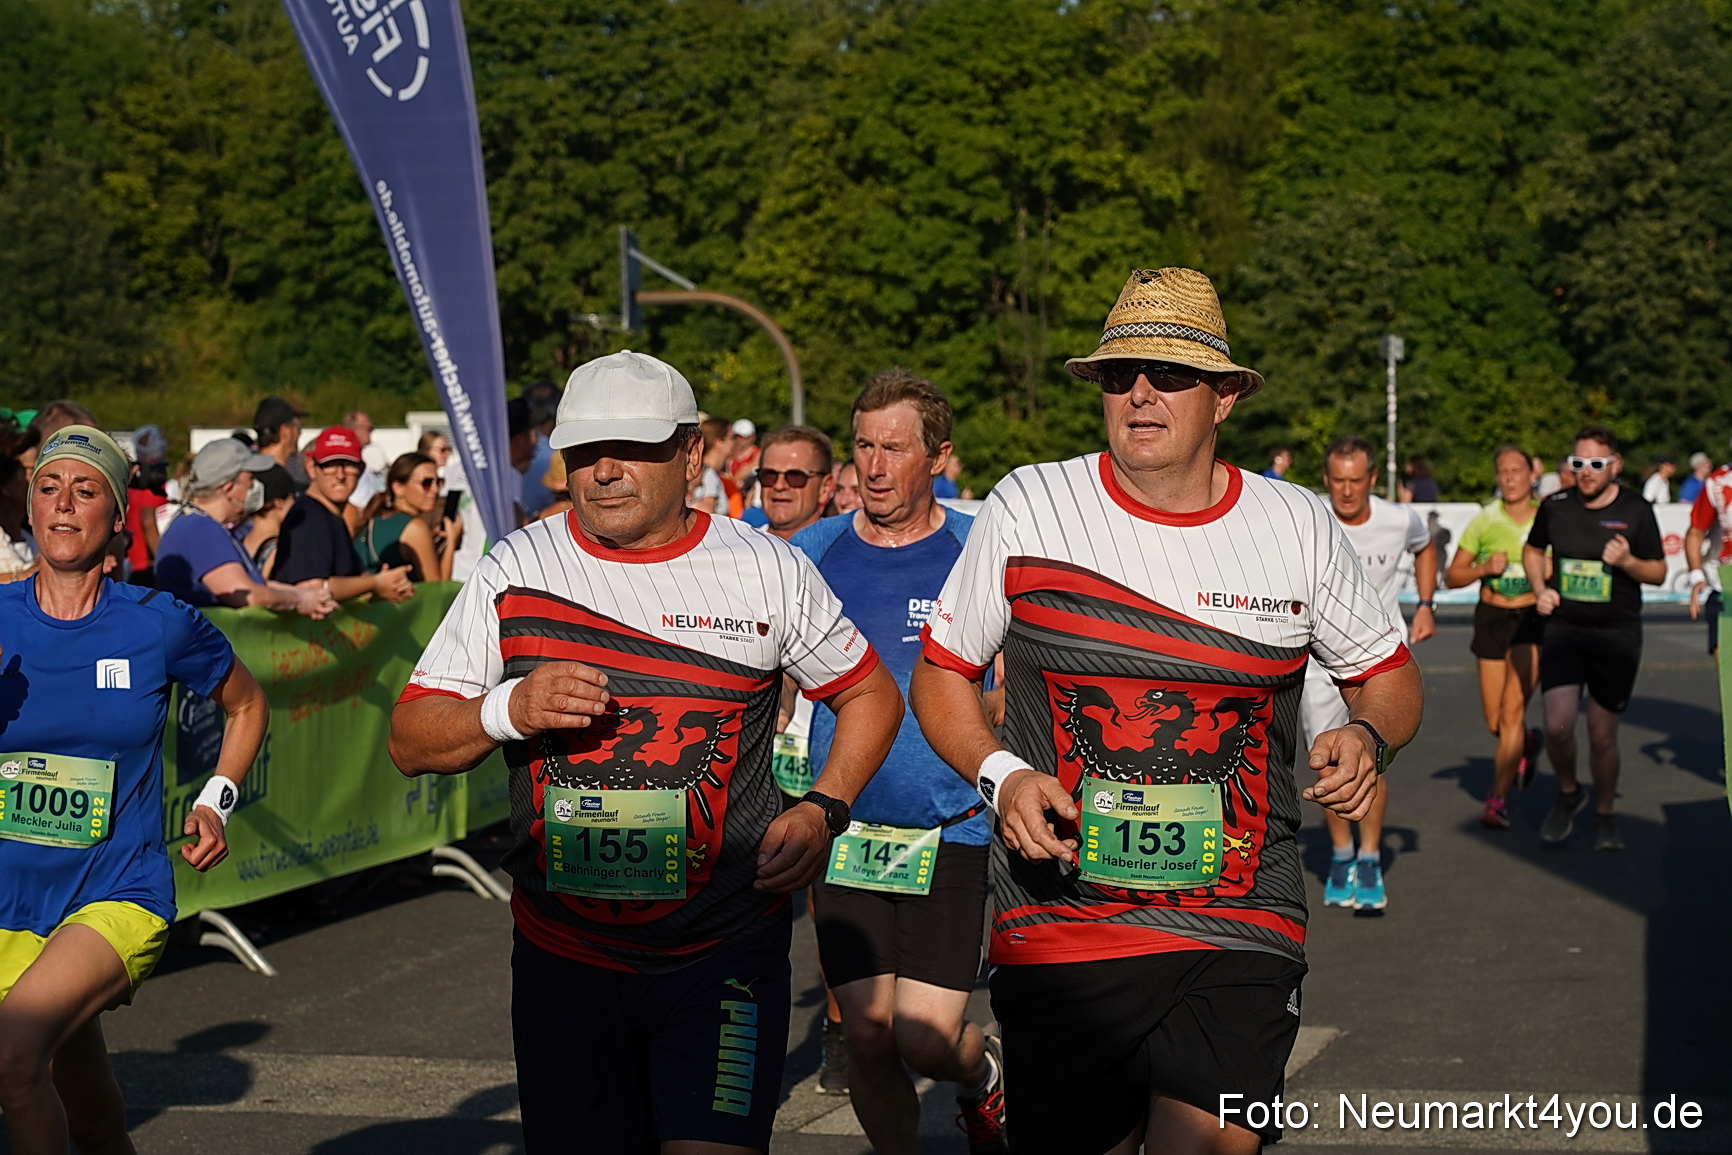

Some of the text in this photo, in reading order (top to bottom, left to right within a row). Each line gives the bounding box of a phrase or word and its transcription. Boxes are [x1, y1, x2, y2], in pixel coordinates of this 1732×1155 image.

[1198, 591, 1291, 614] NEUMARKT
[662, 613, 754, 634] NEUMARKT
[719, 634, 739, 642] STARKE
[21, 768, 58, 778] Firmenlauf
[10, 782, 89, 819] 1009
[574, 809, 619, 818] Firmenlauf
[1115, 802, 1161, 812] Firmenlauf
[11, 813, 82, 832] Meckler Julia
[90, 797, 105, 838] 2022
[575, 828, 649, 864] 155
[1087, 825, 1099, 862] RUN
[1115, 820, 1186, 856] 153
[1202, 827, 1216, 874] 2022
[552, 835, 563, 872] RUN
[665, 833, 678, 883] 2022
[835, 844, 849, 870] RUN
[860, 839, 909, 869] 142
[917, 850, 931, 885] 2022
[1102, 854, 1198, 870] Haberler Josef
[562, 862, 665, 880] Behninger Charly
[852, 864, 882, 878] Meyer
[712, 1000, 758, 1117] PUMA
